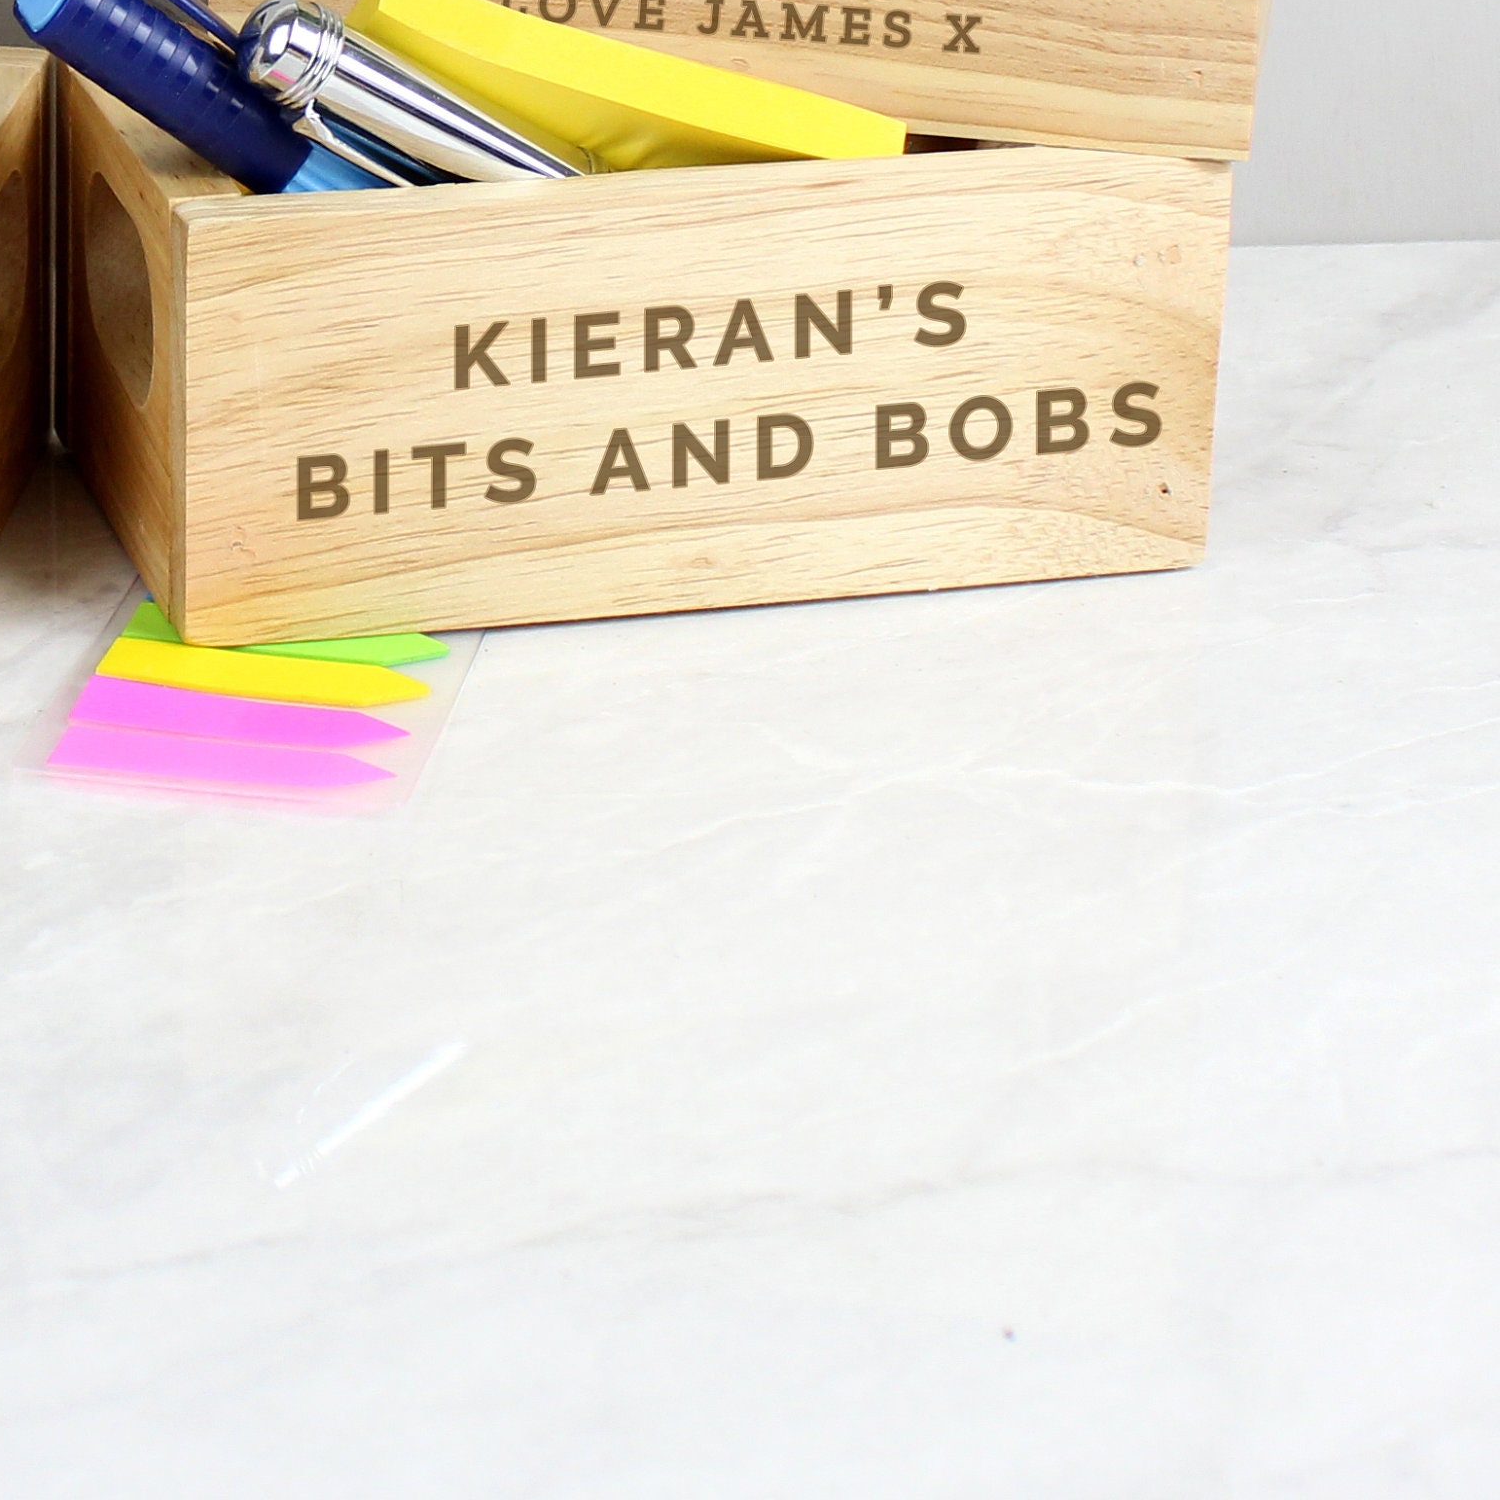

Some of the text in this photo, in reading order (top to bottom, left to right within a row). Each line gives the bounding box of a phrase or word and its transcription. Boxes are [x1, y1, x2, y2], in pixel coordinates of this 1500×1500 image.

[941, 12, 983, 55] X
[454, 281, 968, 390] KIERAN'S
[296, 381, 1164, 522] BITS AND BOBS
